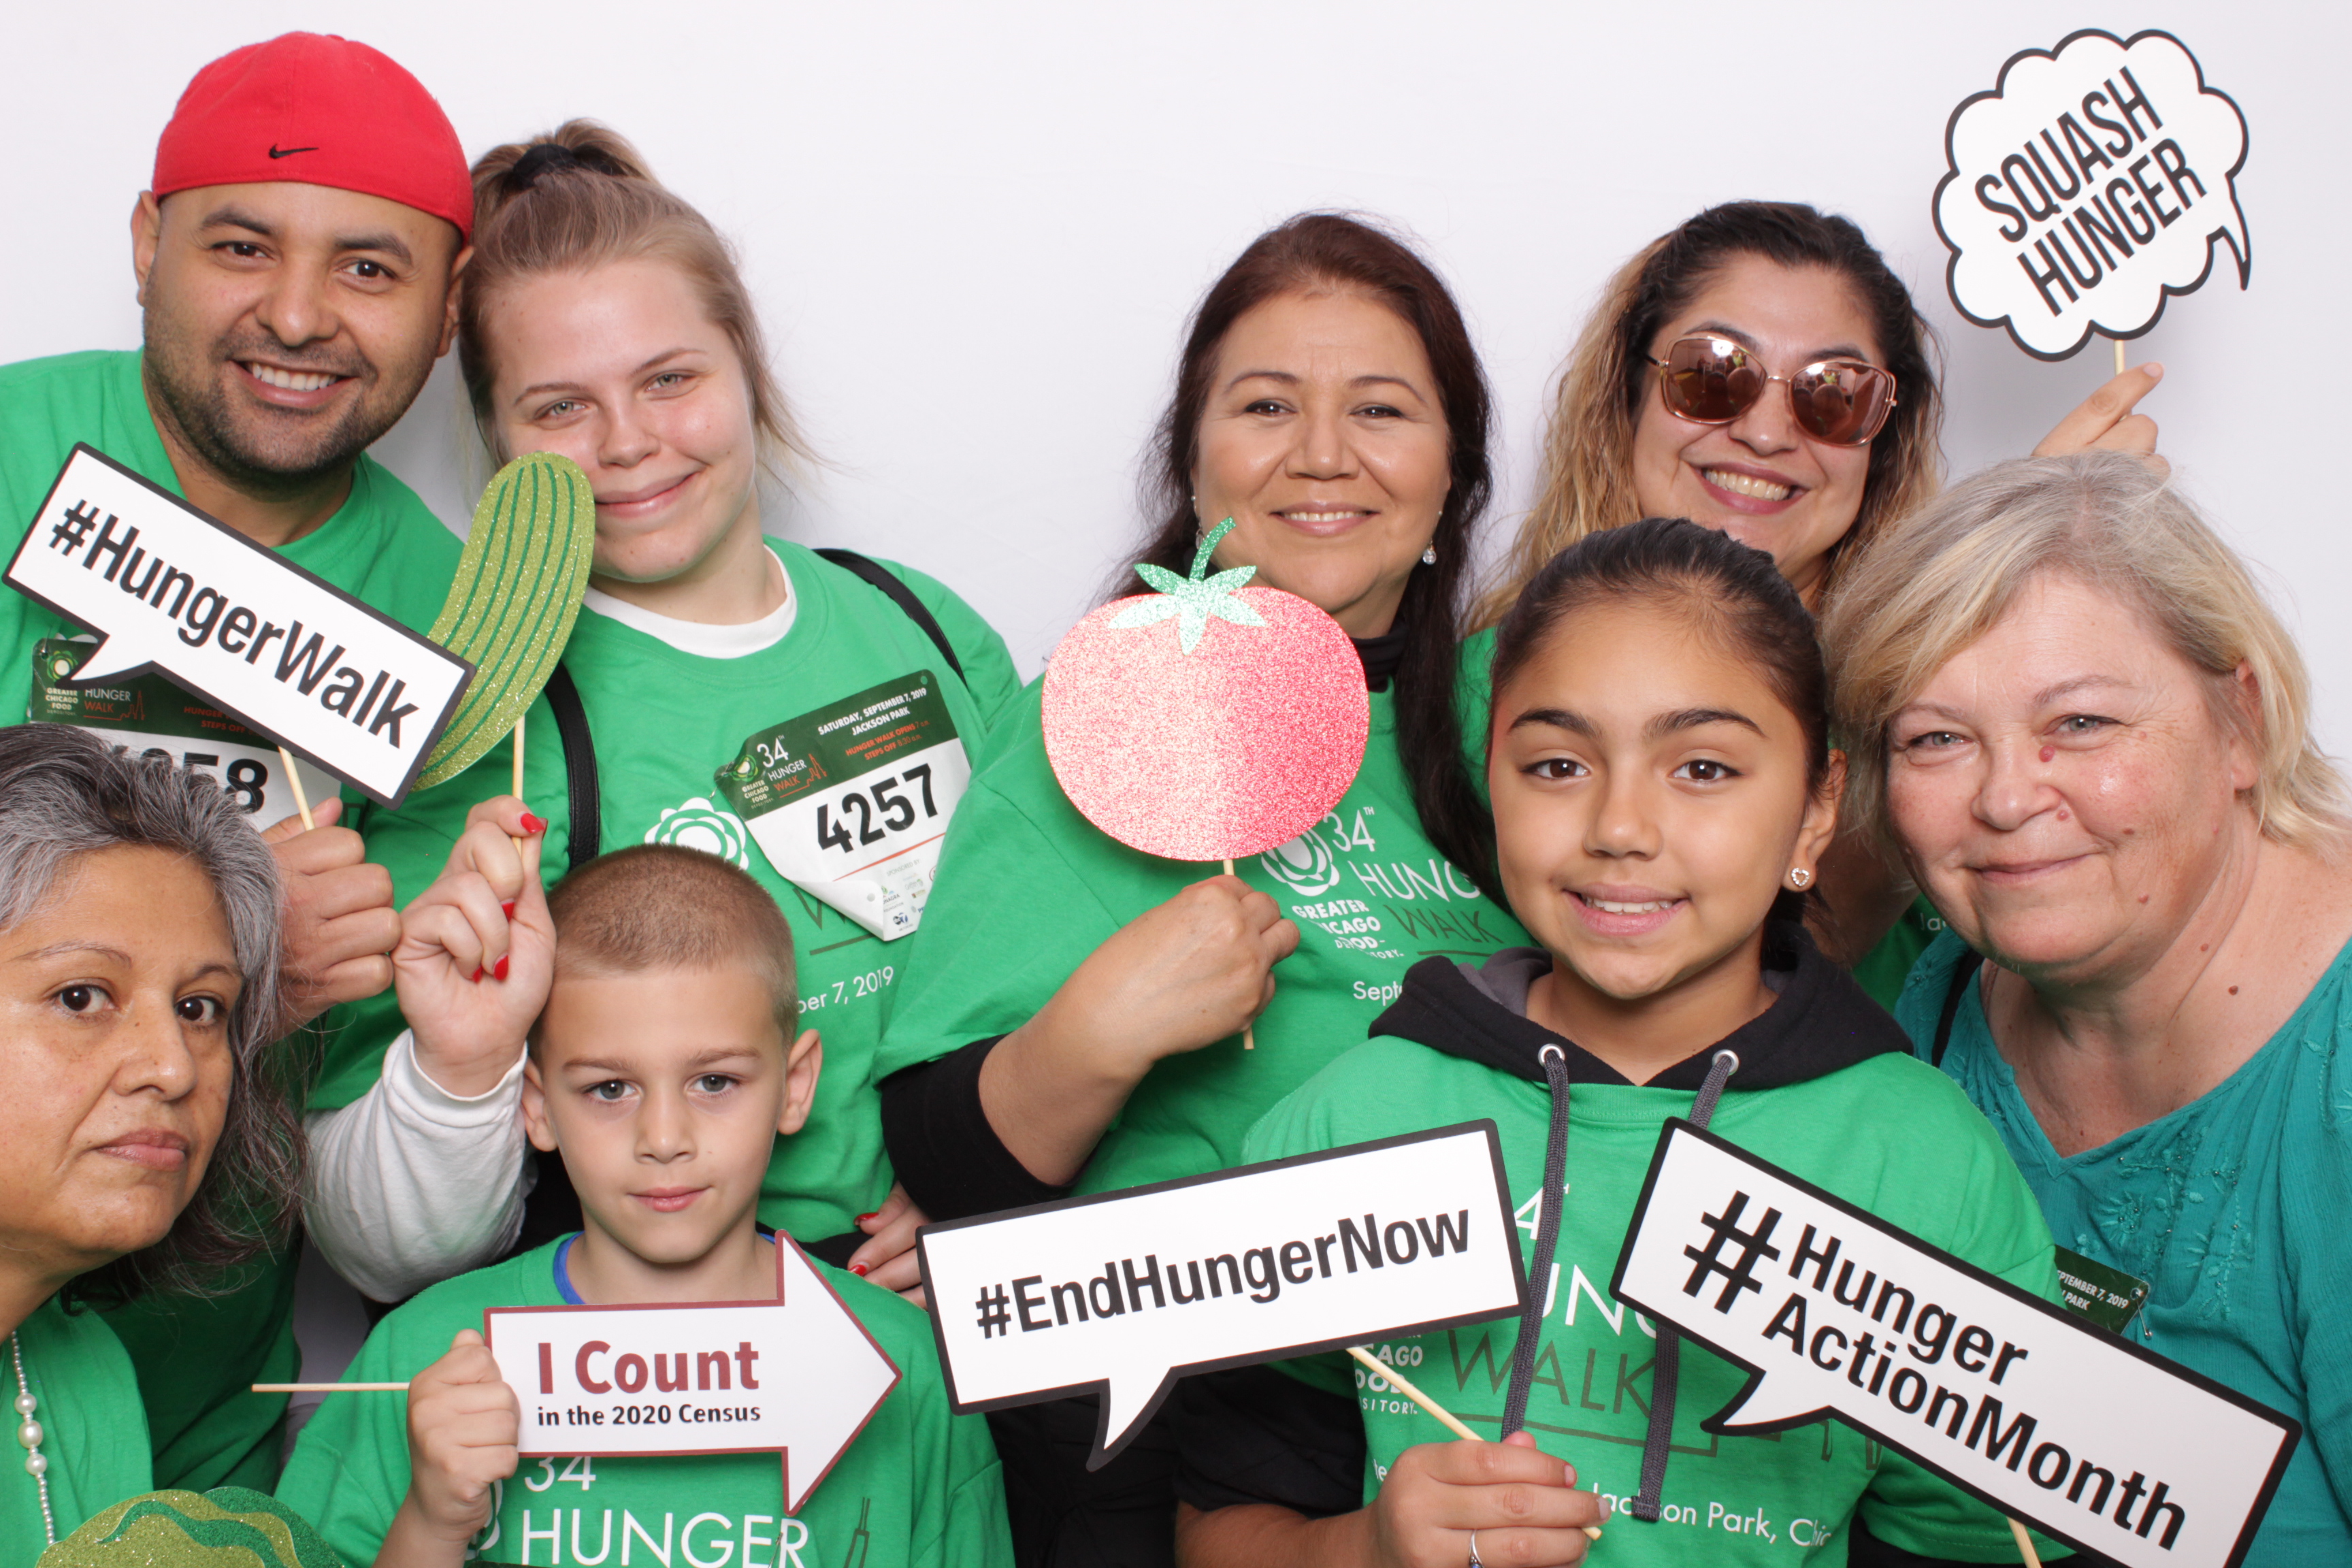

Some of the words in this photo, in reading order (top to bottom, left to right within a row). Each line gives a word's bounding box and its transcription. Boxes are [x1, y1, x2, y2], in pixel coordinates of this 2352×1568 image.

[1975, 65, 2163, 242] SQUASH
[2016, 138, 2207, 316] HUNGER
[49, 499, 420, 749] #HungerWalk
[45, 694, 79, 704] CHICAGO
[46, 687, 78, 696] GREATER
[85, 688, 131, 702] HUNGER
[51, 702, 72, 710] FOOD
[84, 701, 114, 713] WALK
[184, 706, 223, 718] HUNGER
[818, 712, 863, 735] SATURDAY,
[863, 696, 905, 717] SEPTEMBER
[904, 694, 911, 702] 7,
[911, 687, 927, 700] 2019
[201, 720, 227, 730] STEPS
[228, 725, 246, 733] OFF
[852, 713, 891, 736] JACKSON
[889, 706, 911, 720] PARK
[845, 739, 876, 756] HUNGER
[875, 730, 896, 744] WALK
[896, 723, 917, 736] OPENS
[864, 747, 885, 760] STEPS
[883, 742, 896, 752] OFF
[897, 736, 911, 747] 8:30
[768, 760, 807, 781] HUNGER
[742, 779, 766, 793] GREATER
[744, 785, 769, 799] CHICAGO
[773, 775, 801, 791] WALK
[752, 794, 768, 803] FOOD
[817, 763, 938, 853] 4257
[886, 862, 913, 877] SPONSORED
[1292, 900, 1369, 919] GREATER
[1383, 904, 1504, 943] WALK
[832, 981, 848, 1004] 7,
[853, 966, 894, 997] 2019
[975, 1209, 1469, 1339] #EndHungerNow
[2065, 1292, 2091, 1310] PARK
[2097, 1288, 2107, 1301] 7,
[2106, 1293, 2129, 1309] 2019
[538, 1343, 553, 1394] I
[575, 1340, 759, 1394] Count
[1448, 1329, 1656, 1419] WALK
[538, 1406, 559, 1425] in
[567, 1405, 604, 1425] the
[612, 1405, 671, 1424] 2020
[679, 1404, 761, 1424] Census
[1761, 1294, 2187, 1552] ActionMonth
[1708, 1501, 1777, 1544] Park,
[522, 1509, 808, 1568] HUNGER
